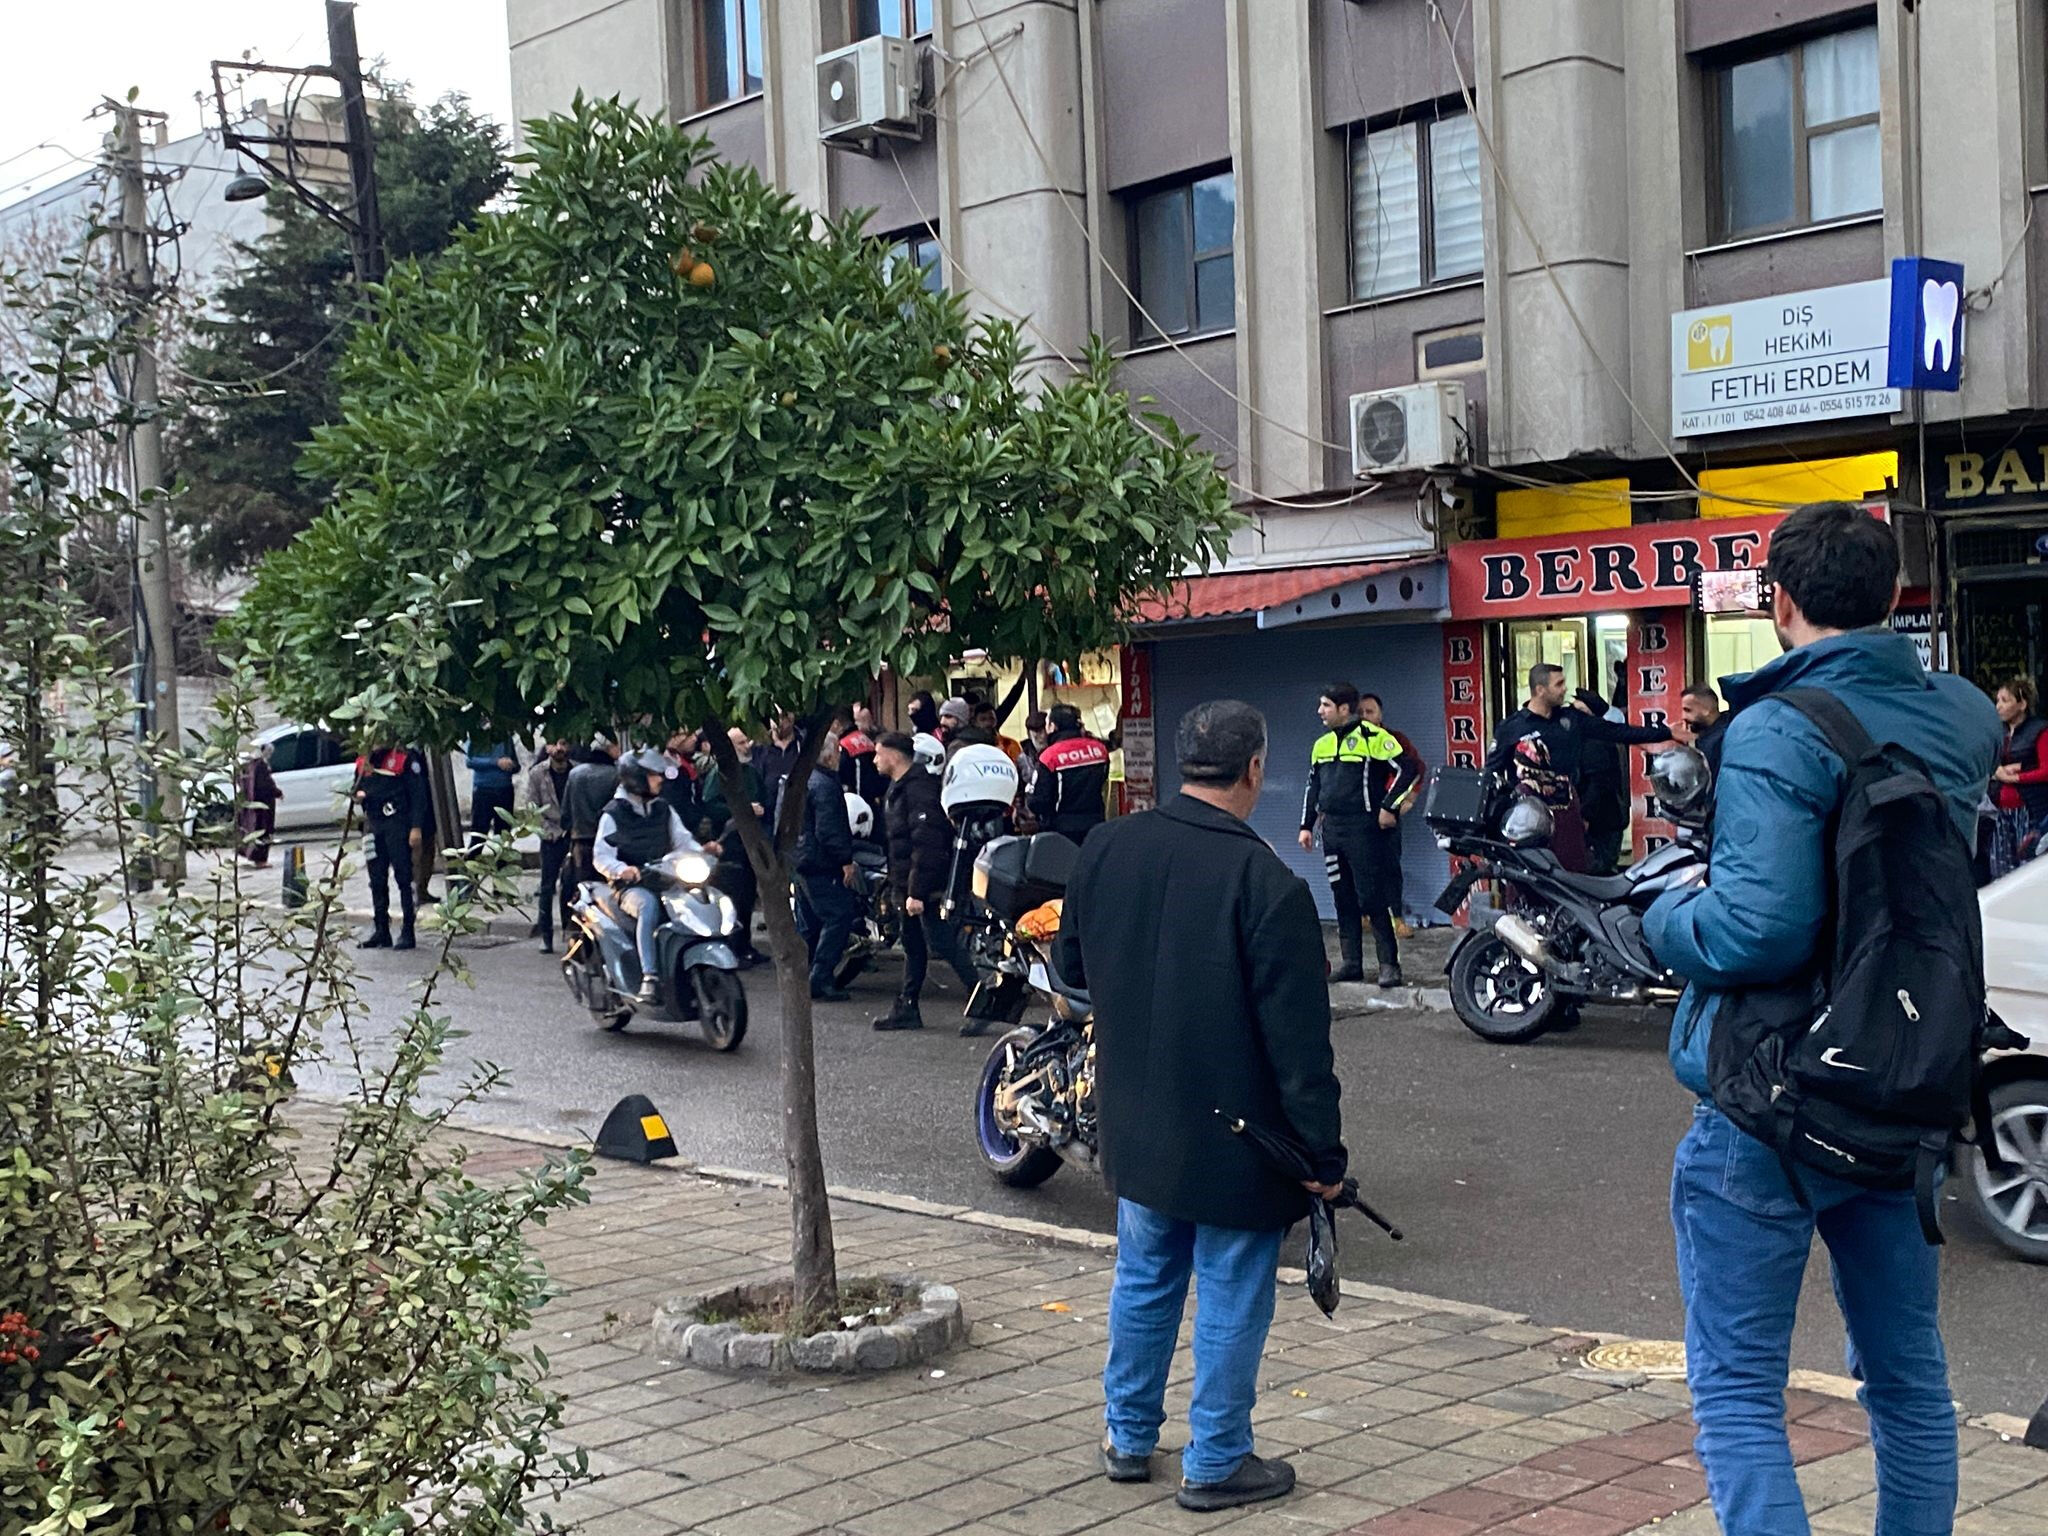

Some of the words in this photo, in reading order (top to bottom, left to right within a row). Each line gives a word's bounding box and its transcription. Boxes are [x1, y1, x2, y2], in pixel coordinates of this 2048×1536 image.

[1785, 359, 1870, 392] ERDEM
[1721, 412, 1735, 425] 101
[1744, 408, 1765, 422] 0542
[1767, 406, 1784, 418] 408
[1786, 404, 1797, 416] 40
[1799, 402, 1811, 414] 46
[1820, 399, 1843, 412] 0554
[1844, 396, 1863, 410] 515
[1864, 394, 1877, 407] 72
[1878, 392, 1891, 405] 26
[1945, 444, 2048, 499] BA
[1481, 531, 1773, 602] BERBE
